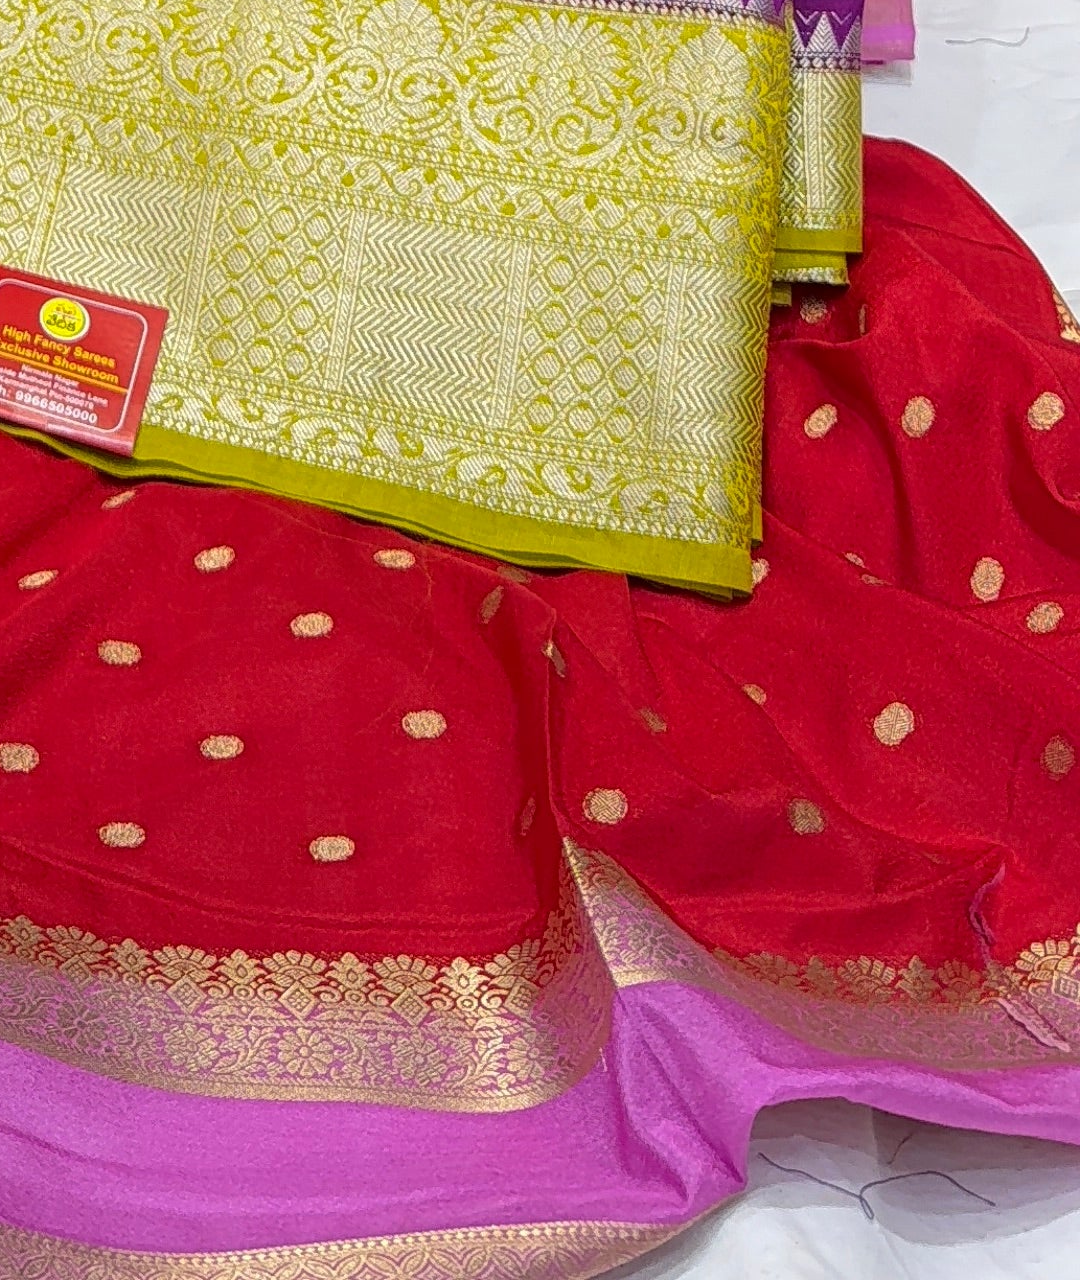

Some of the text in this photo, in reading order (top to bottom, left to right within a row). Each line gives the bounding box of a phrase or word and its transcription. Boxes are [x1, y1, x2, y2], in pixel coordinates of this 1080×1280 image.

[2, 325, 116, 368] High Fancy Sarees
[52, 355, 119, 384] Showroom
